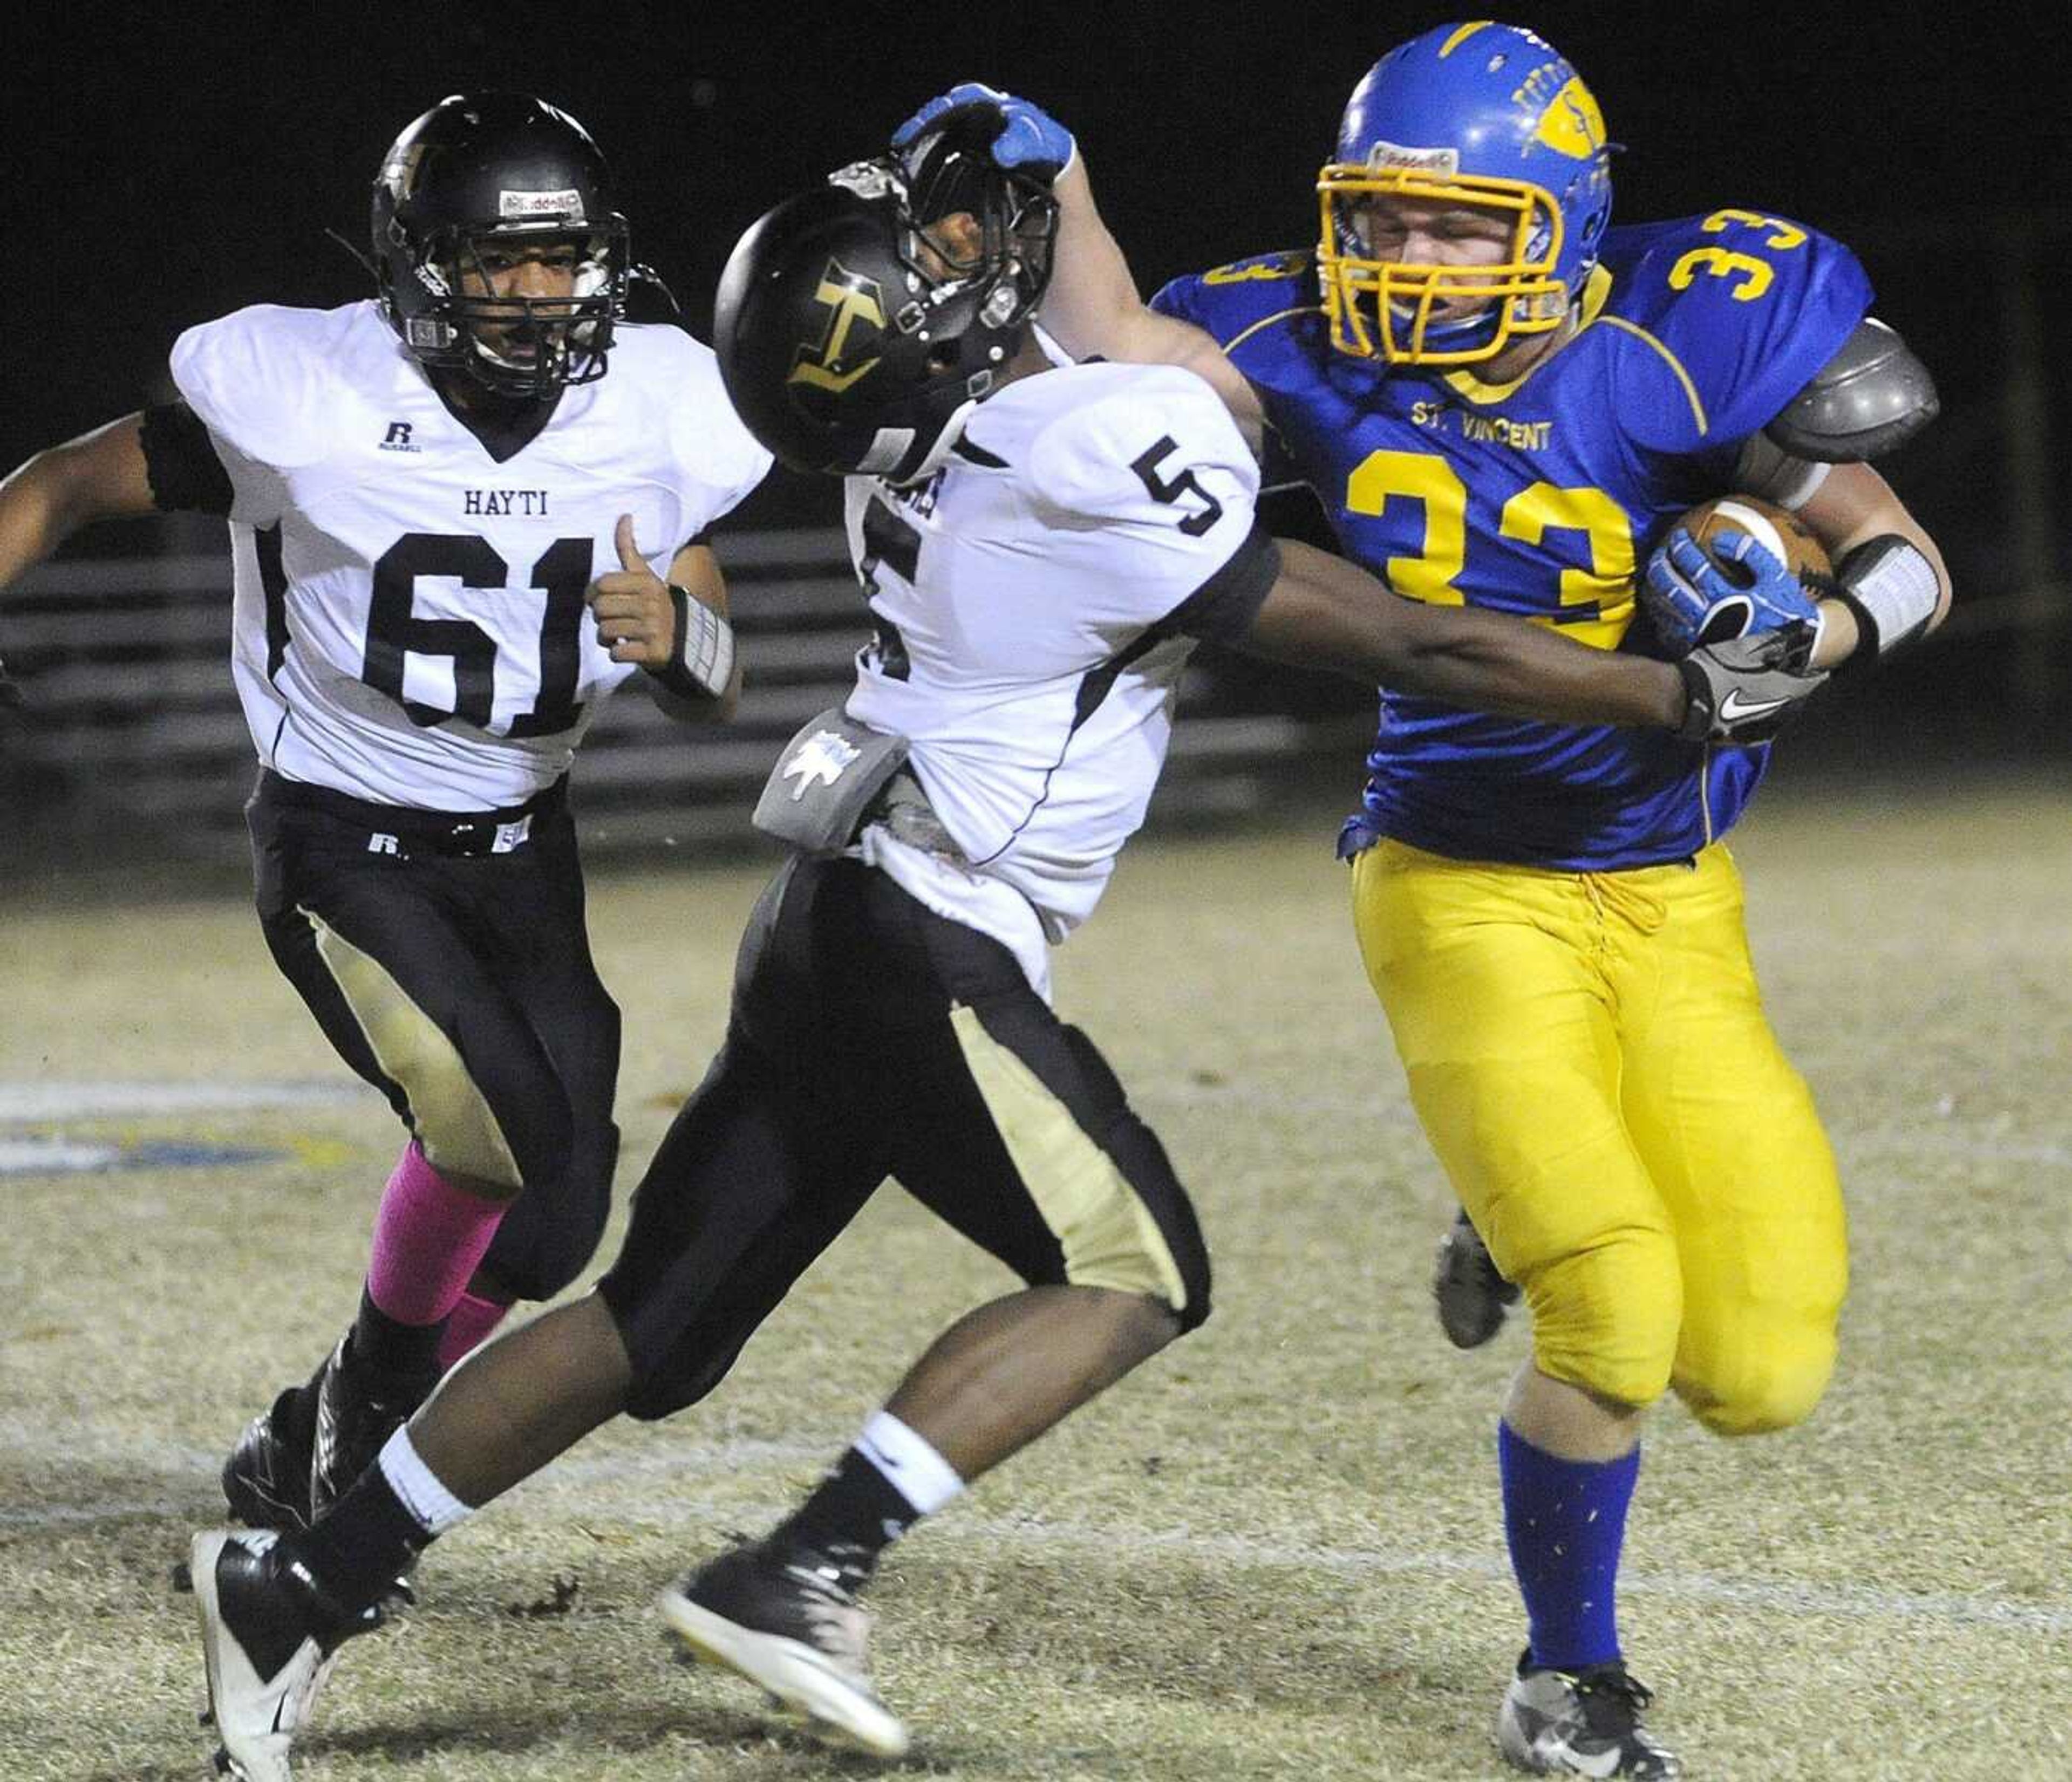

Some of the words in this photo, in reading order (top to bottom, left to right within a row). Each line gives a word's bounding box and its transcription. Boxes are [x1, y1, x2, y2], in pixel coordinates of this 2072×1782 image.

[1668, 209, 1808, 301] 33
[385, 422, 412, 443] R
[1410, 401, 1448, 431] ST.
[1463, 412, 1553, 451] VINCENT
[464, 490, 547, 515] HAYTI
[1130, 435, 1222, 536] 5
[1346, 449, 1635, 651] 33
[363, 532, 594, 738] 61
